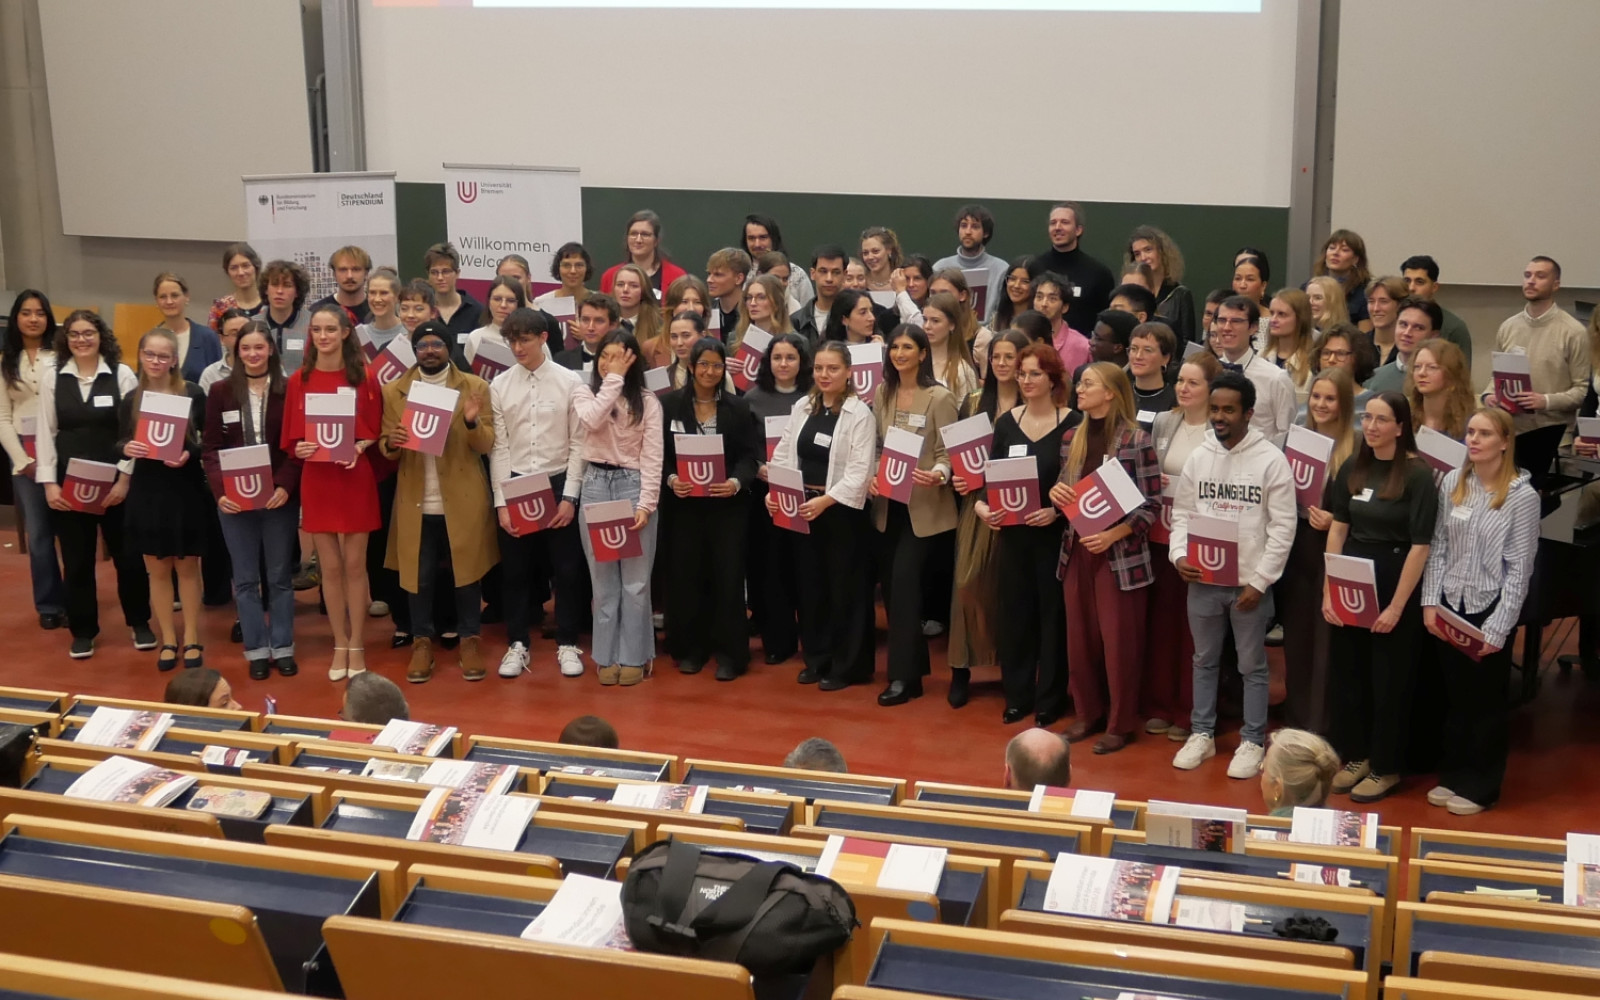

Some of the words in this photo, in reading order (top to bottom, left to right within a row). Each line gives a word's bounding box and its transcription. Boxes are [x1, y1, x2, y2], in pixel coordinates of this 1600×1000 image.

[341, 192, 383, 200] Deutschland
[460, 236, 550, 252] Willkommen
[460, 254, 502, 268] Welc
[1198, 480, 1216, 500] LOS
[1217, 483, 1262, 504] ANGELES
